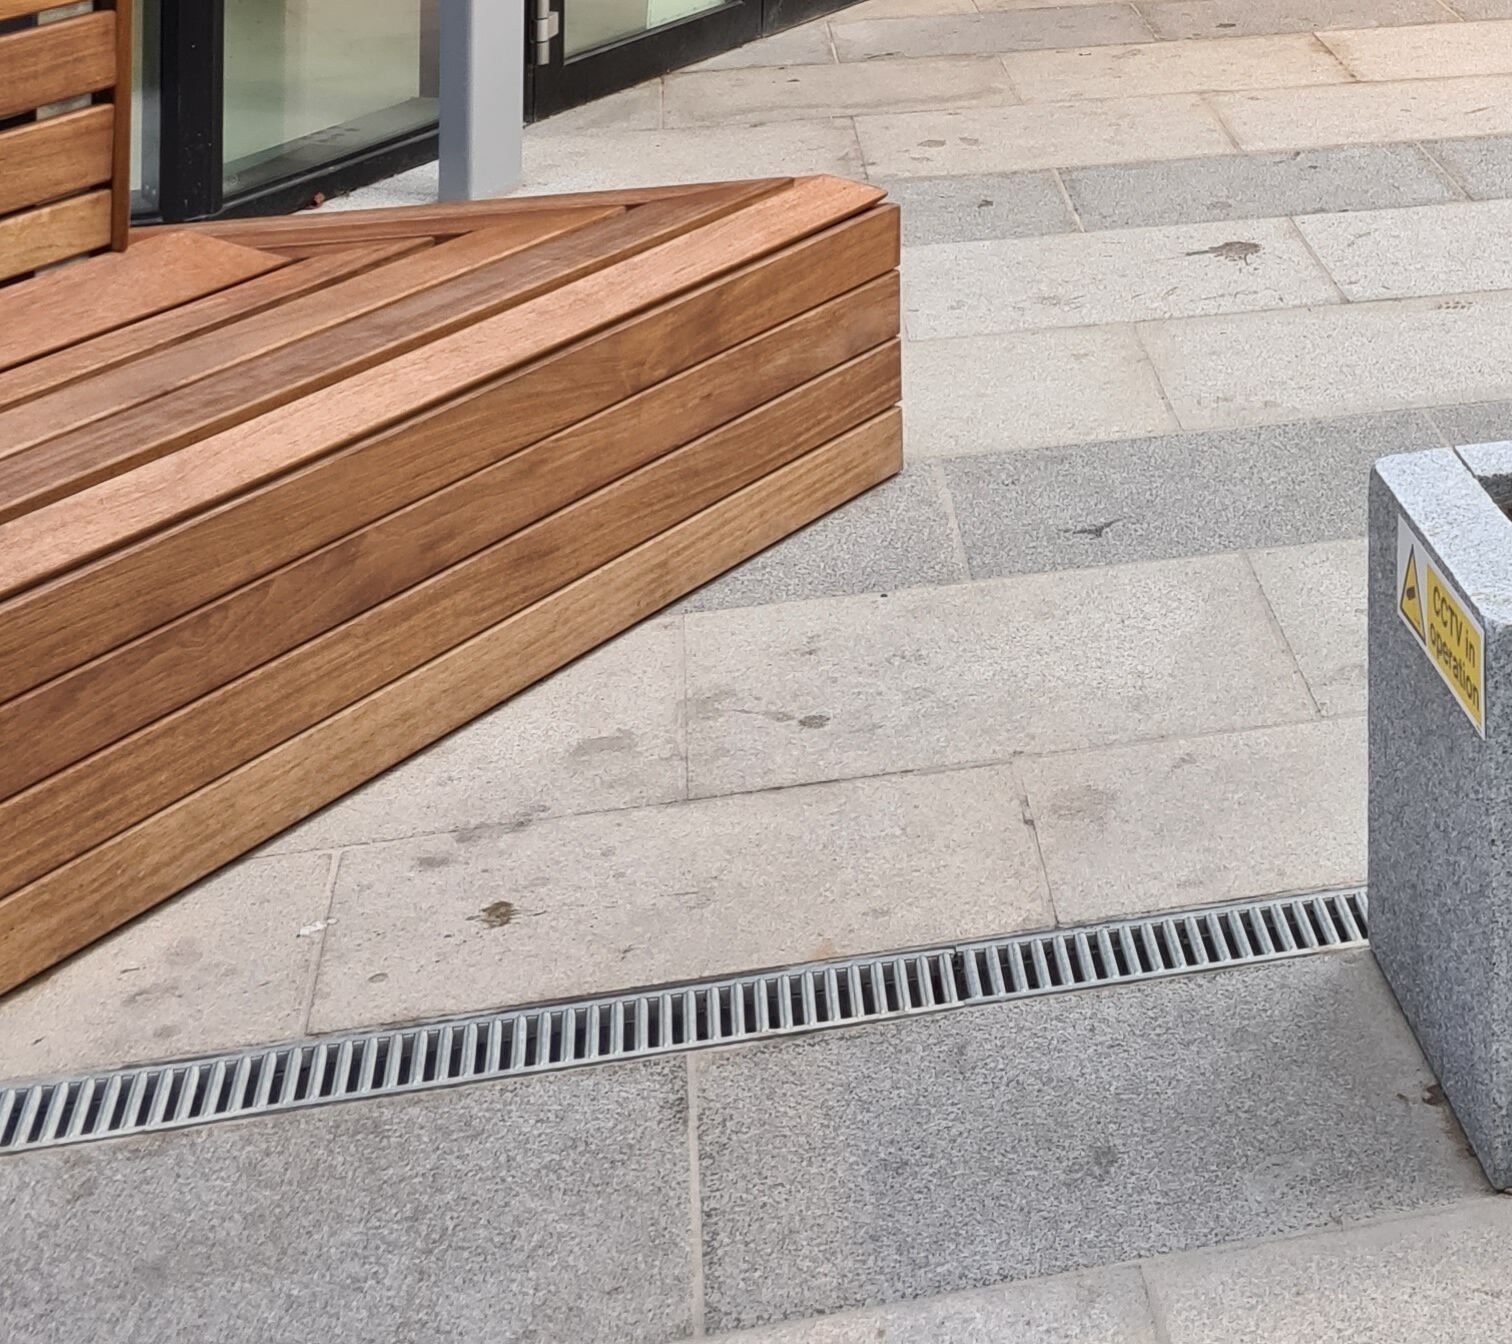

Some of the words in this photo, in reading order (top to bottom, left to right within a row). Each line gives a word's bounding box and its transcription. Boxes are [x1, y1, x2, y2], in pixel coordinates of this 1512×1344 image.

[1430, 623, 1480, 710] operation
[1433, 586, 1463, 647] CCTV
[1465, 629, 1476, 668] in
